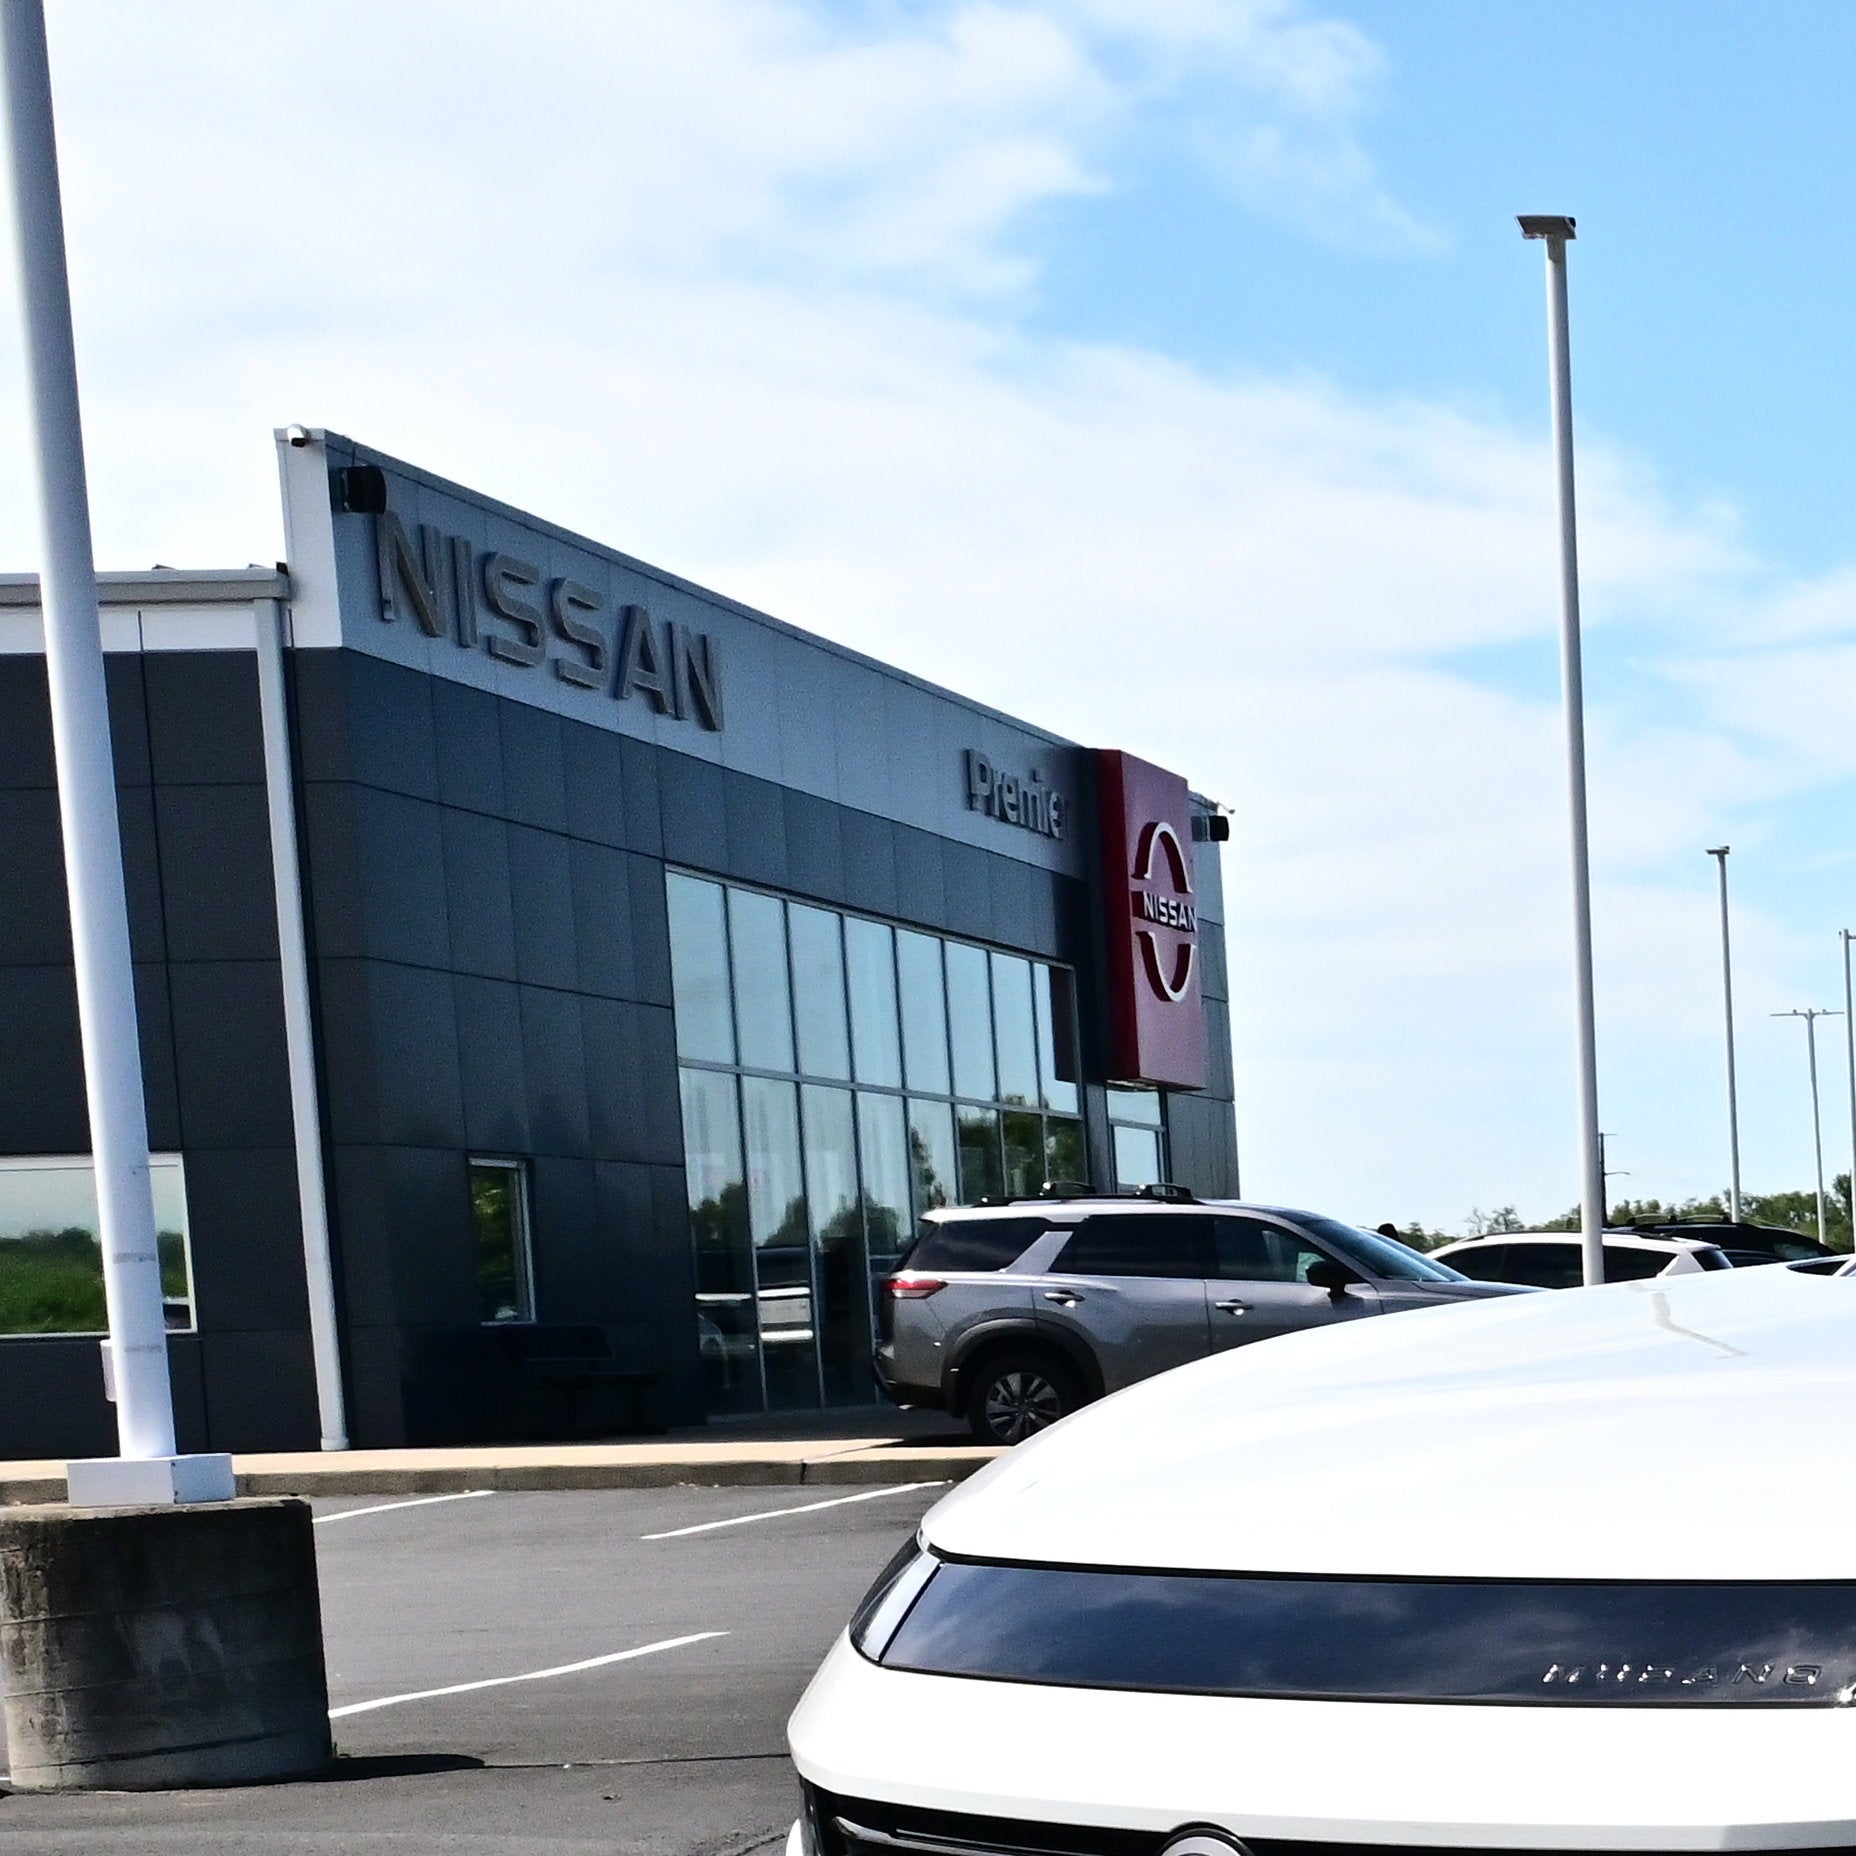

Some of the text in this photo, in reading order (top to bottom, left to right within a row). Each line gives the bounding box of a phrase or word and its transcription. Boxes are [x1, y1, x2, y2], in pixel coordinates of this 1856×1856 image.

[375, 508, 723, 731] NISSAN
[963, 748, 1073, 841] Premie
[1143, 891, 1197, 932] NISSAN
